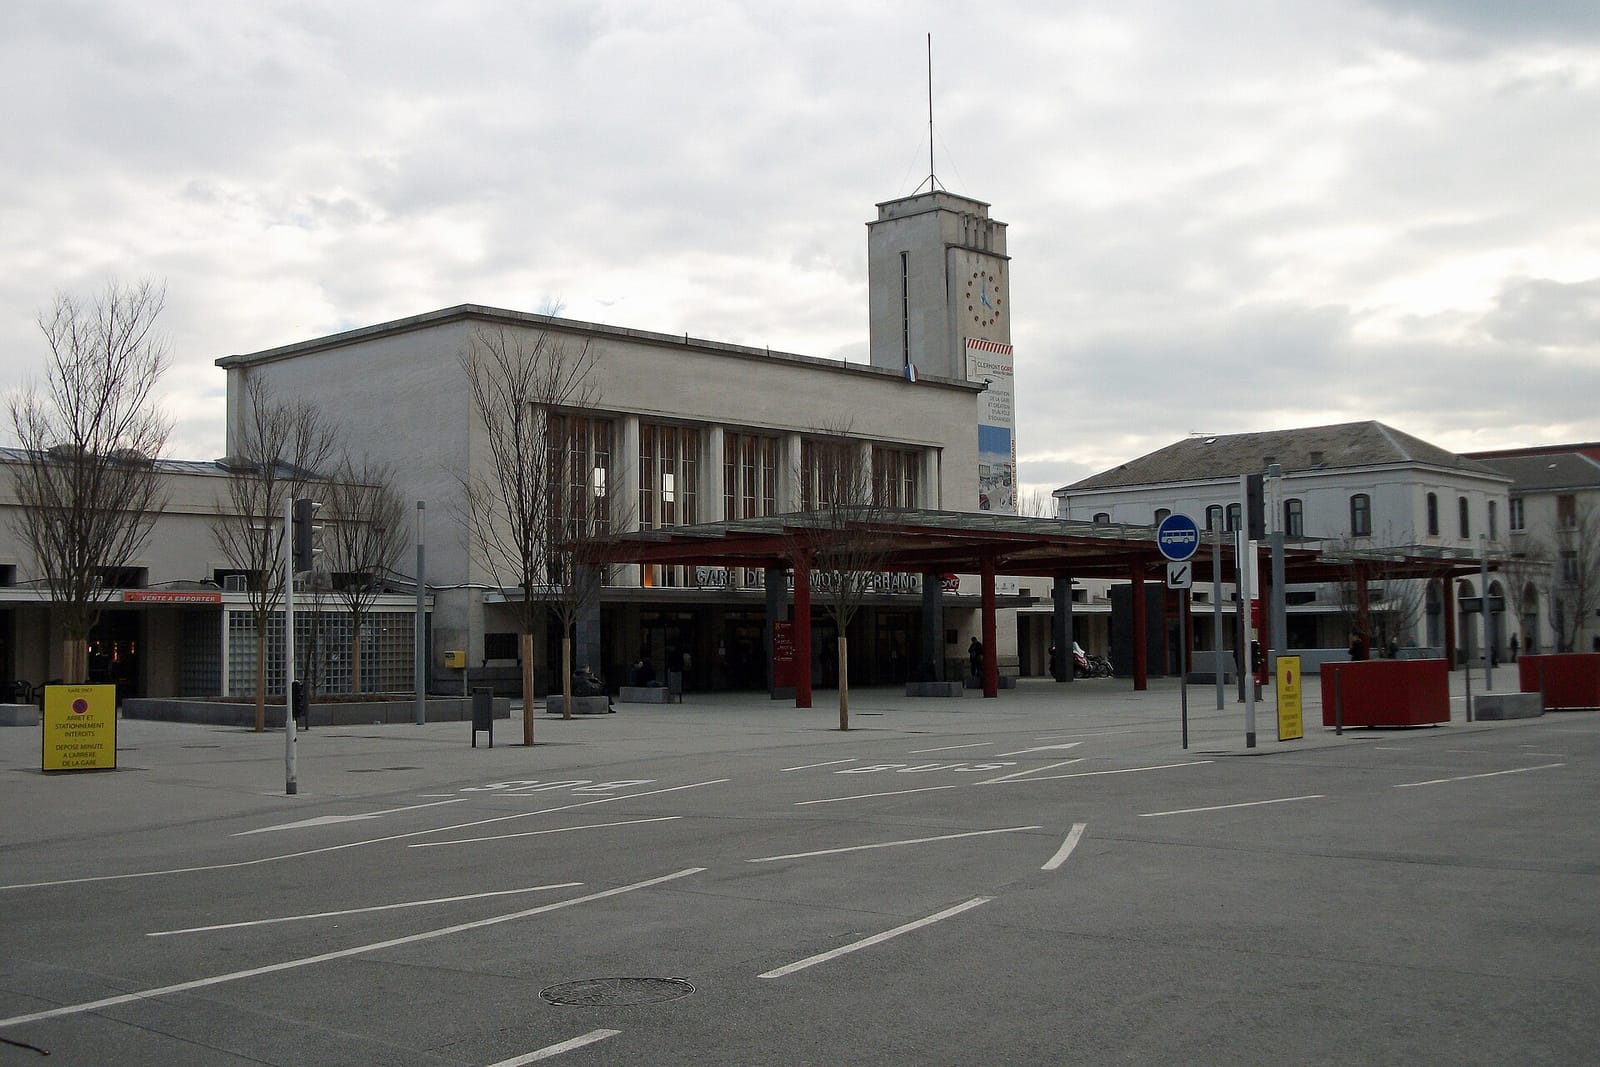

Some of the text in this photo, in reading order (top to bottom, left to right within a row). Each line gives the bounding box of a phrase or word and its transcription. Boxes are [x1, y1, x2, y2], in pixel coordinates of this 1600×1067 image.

[977, 361, 1000, 370] CLERMONT
[695, 566, 736, 587] GARE
[746, 568, 765, 588] DE
[833, 761, 1017, 774] BUS
[459, 779, 657, 792] BUS
